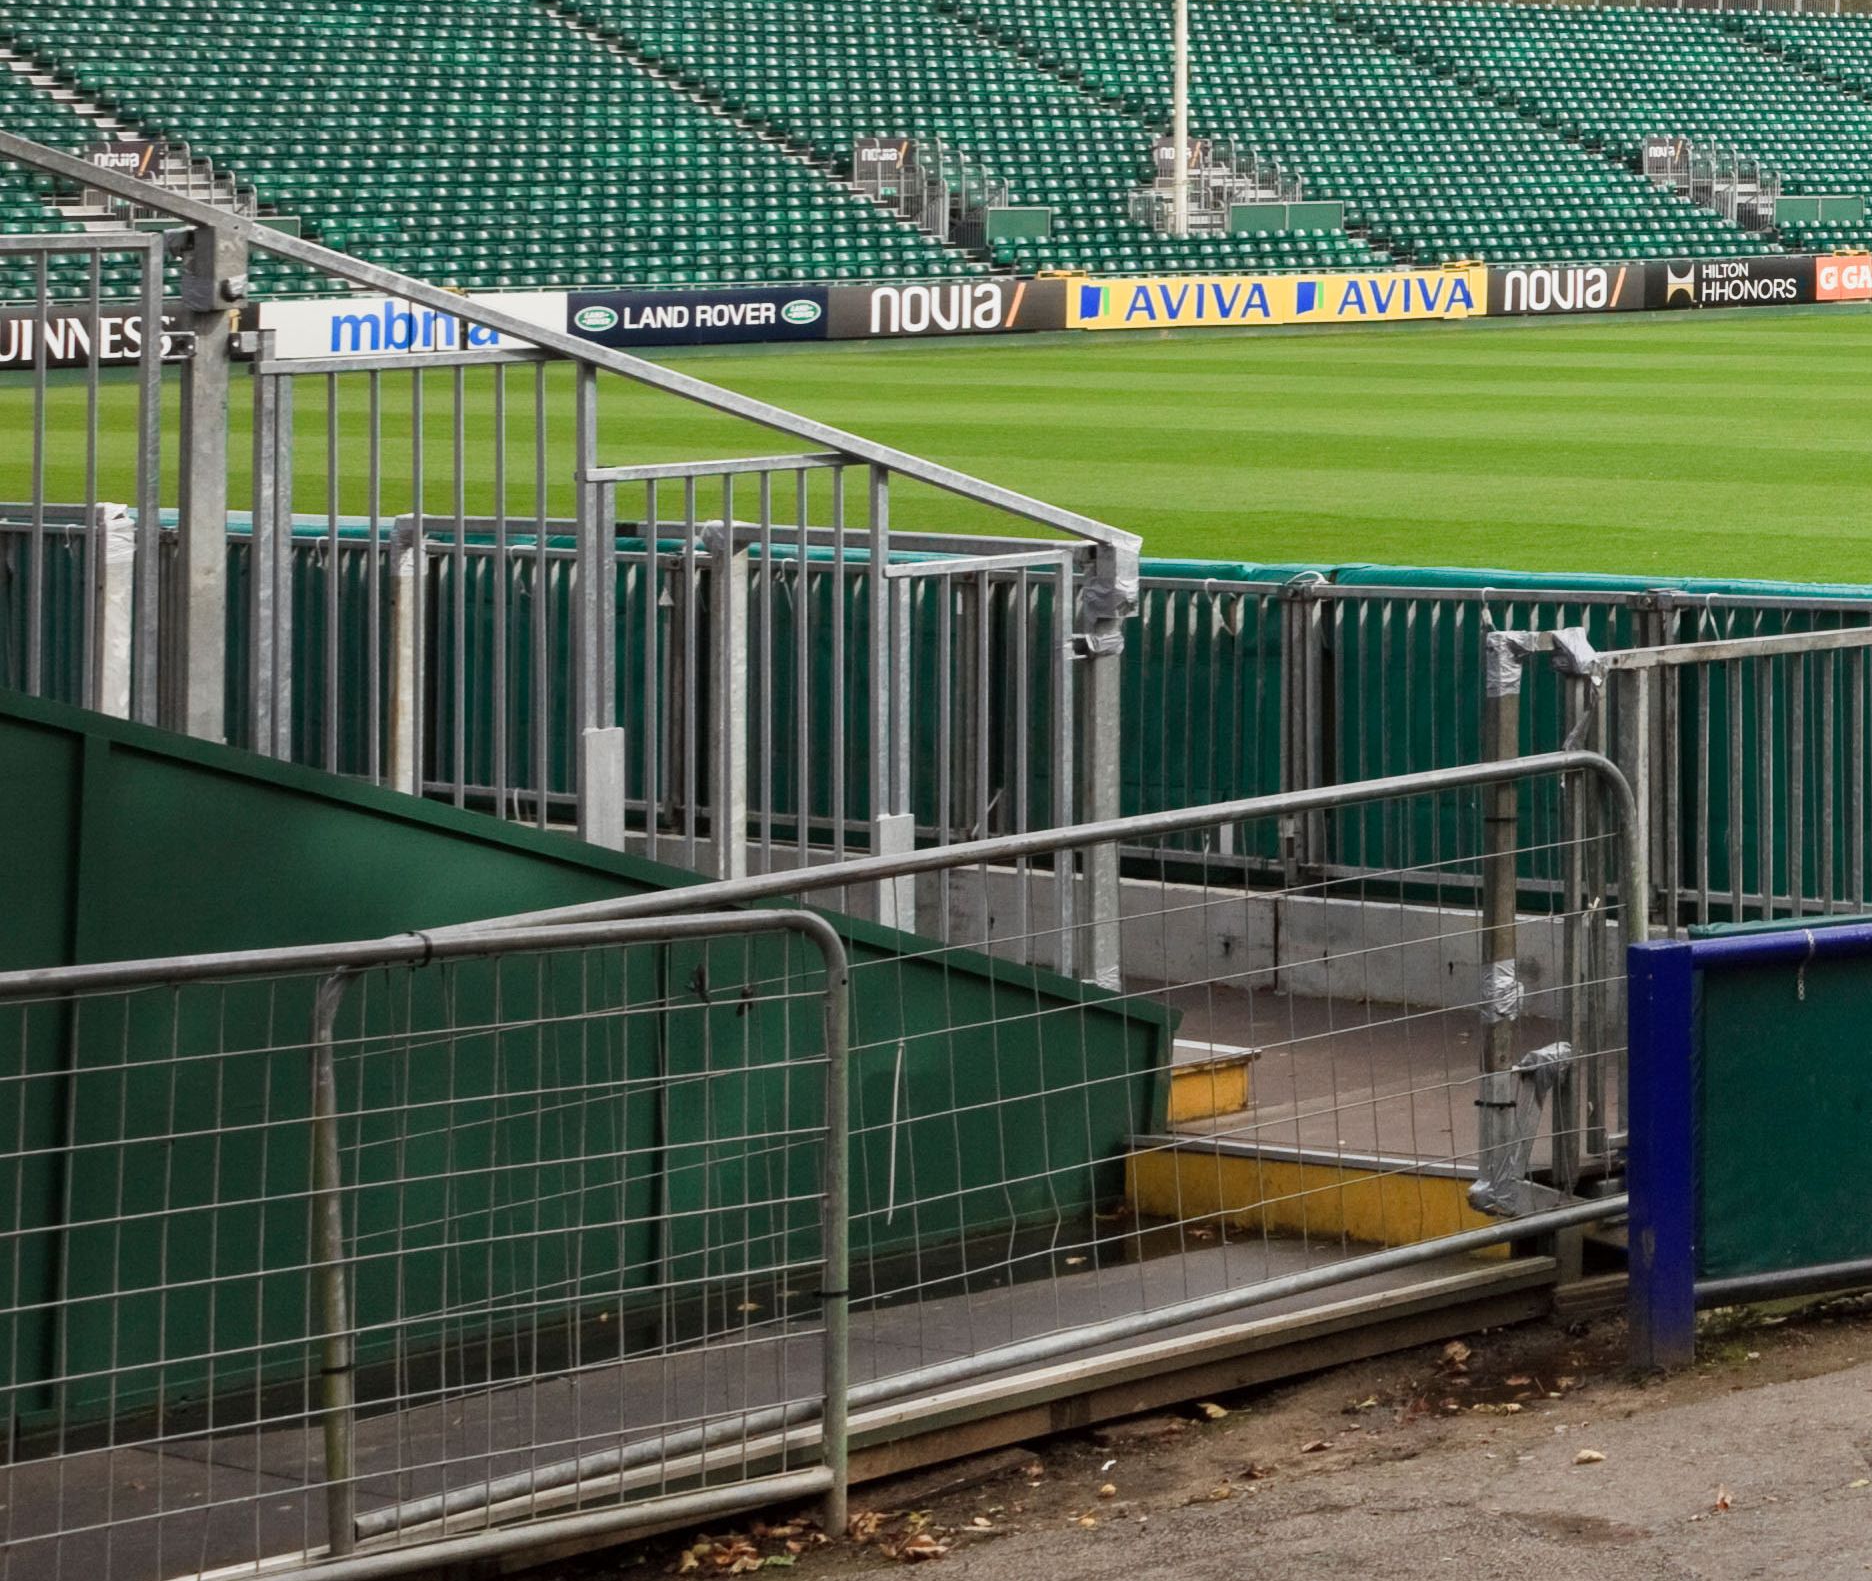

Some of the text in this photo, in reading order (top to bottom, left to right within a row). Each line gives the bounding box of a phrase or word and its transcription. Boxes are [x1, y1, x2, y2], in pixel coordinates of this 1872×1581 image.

[1702, 263, 1749, 279] HILTON
[1125, 283, 1270, 321] AVIVA
[1337, 277, 1474, 315] AVIVA
[1701, 278, 1797, 302] HHONORS
[624, 302, 776, 329] LAND ROVER
